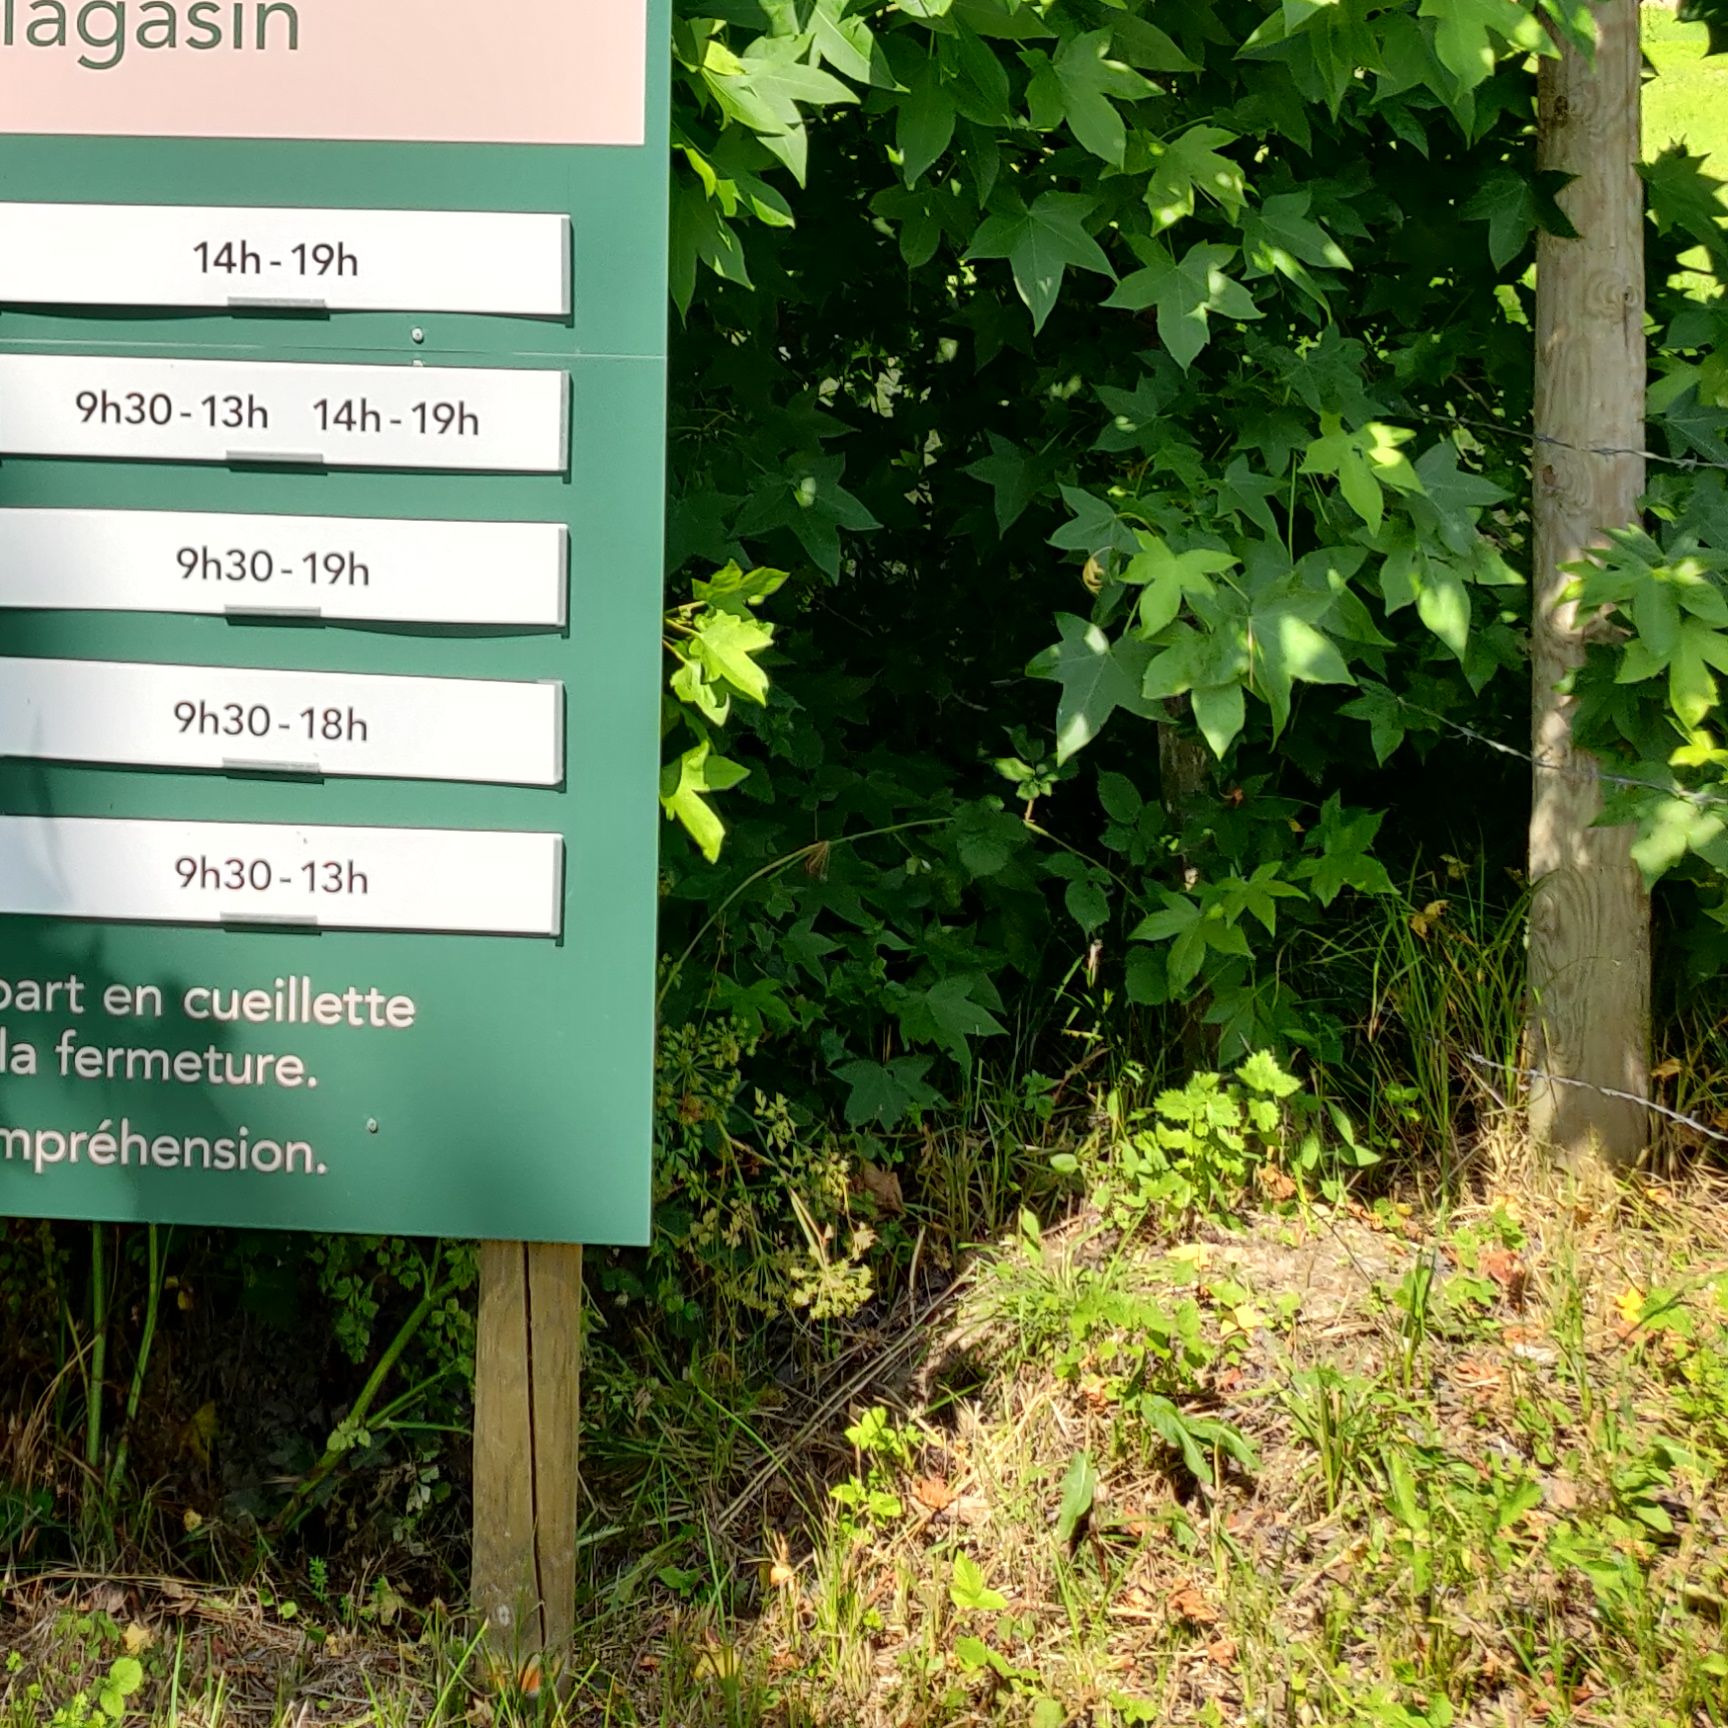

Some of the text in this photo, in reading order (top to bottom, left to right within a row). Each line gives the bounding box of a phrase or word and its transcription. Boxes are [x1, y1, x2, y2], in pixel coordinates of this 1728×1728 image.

[104, 984, 161, 1016] en
[185, 976, 416, 1027] cueillette
[0, 1027, 36, 1074] la
[56, 1030, 319, 1089] fermeture.
